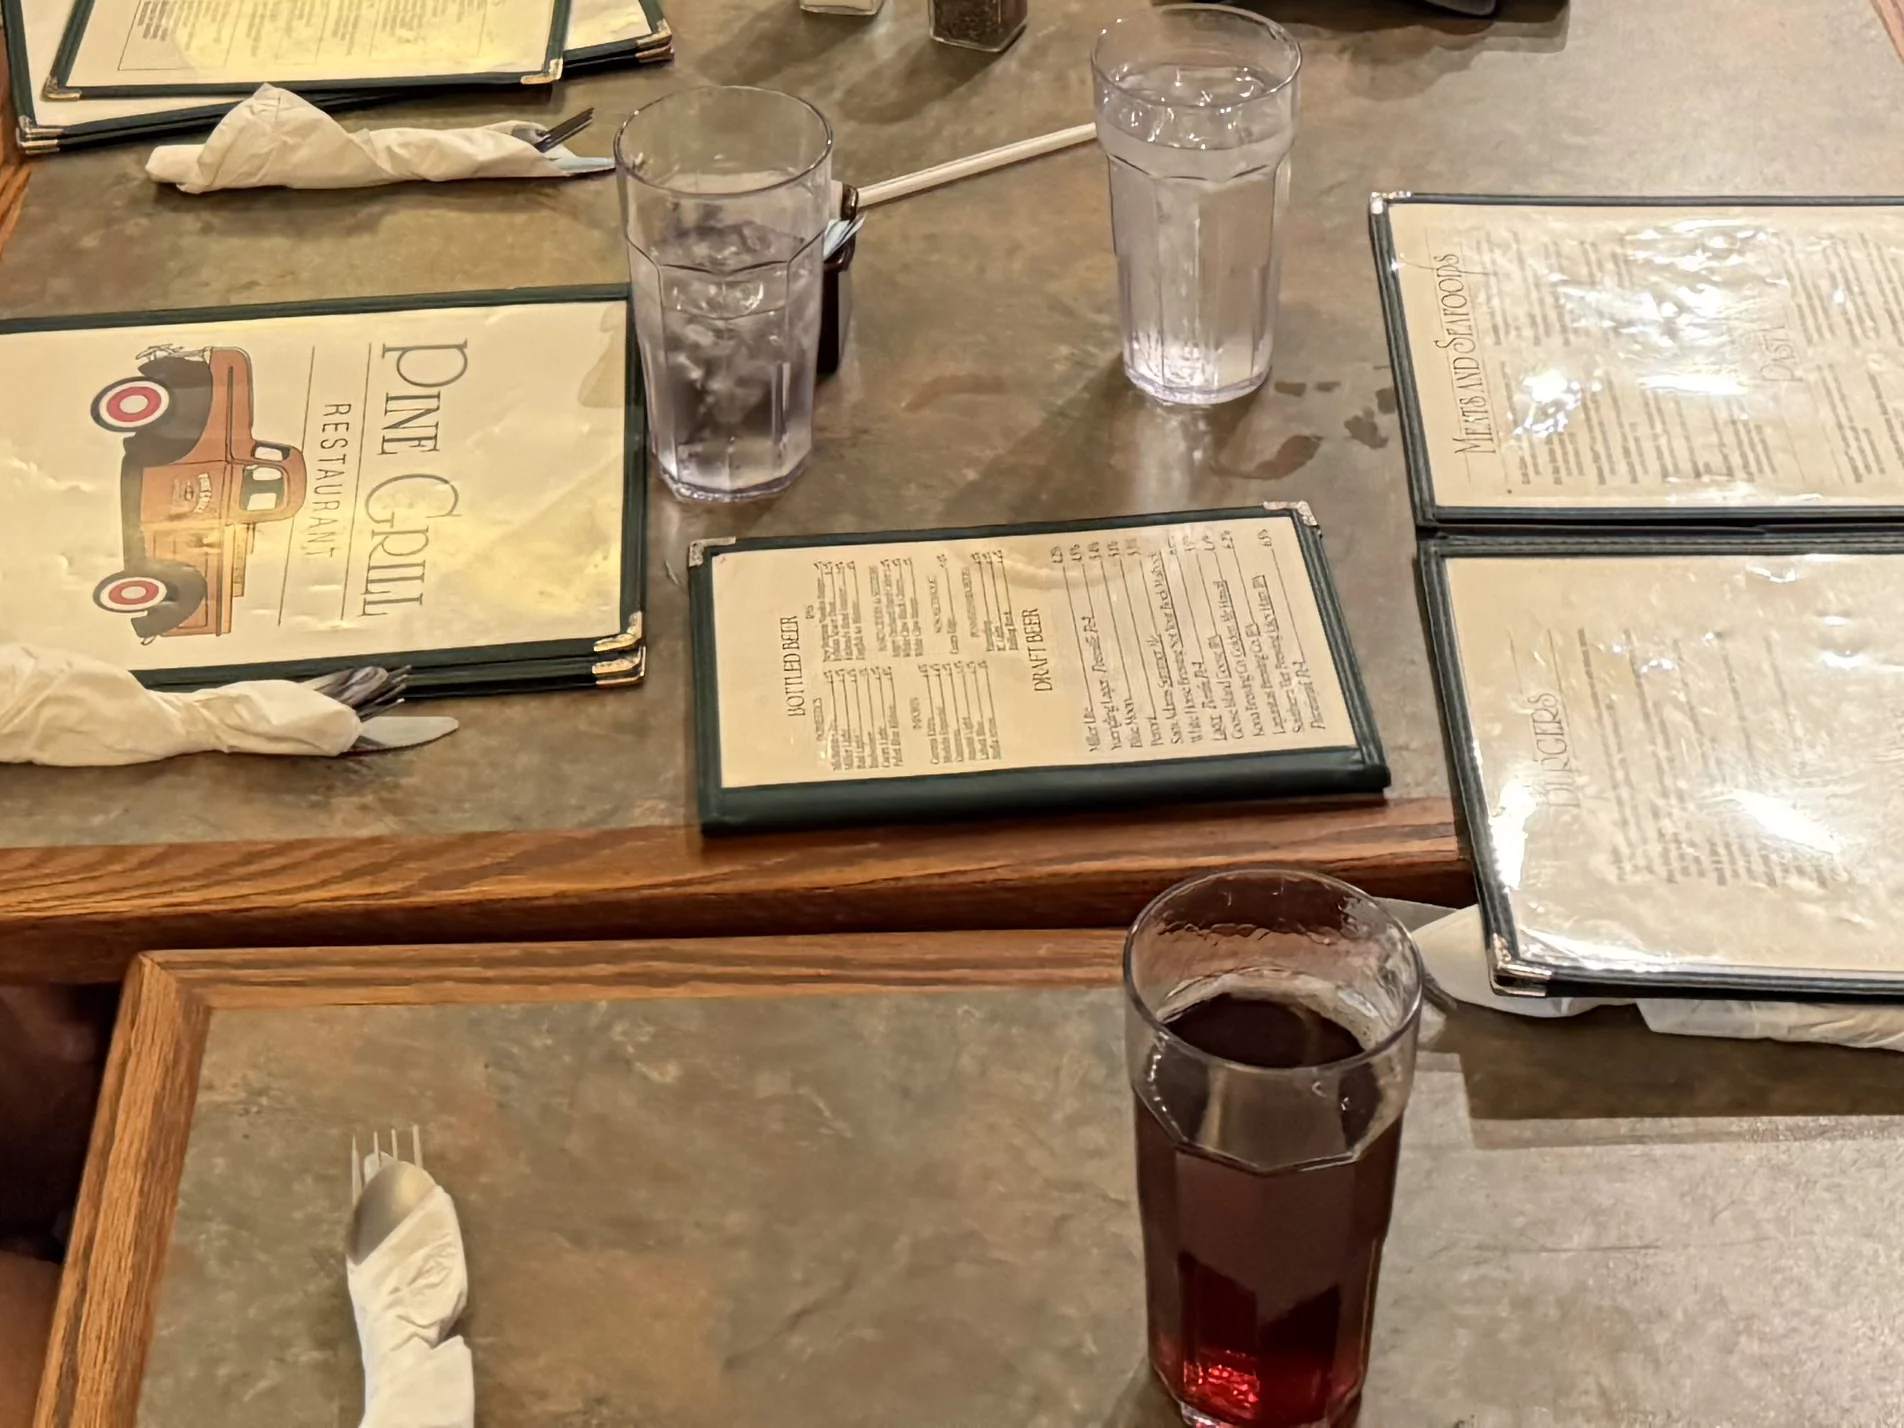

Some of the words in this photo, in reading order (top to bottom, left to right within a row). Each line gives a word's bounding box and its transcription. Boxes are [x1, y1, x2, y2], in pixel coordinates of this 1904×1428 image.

[1431, 254, 1477, 353] SEAFOODS
[1450, 357, 1483, 391] AND
[1759, 325, 1801, 382] PASTA
[377, 338, 468, 455] PINE
[1452, 396, 1496, 454] MEATS
[299, 402, 352, 558] RESTAURANT
[357, 473, 462, 617] GRILL
[780, 616, 799, 650] BEER
[1020, 607, 1044, 643] BEER
[783, 653, 806, 716] BOTTLED
[1027, 645, 1053, 691] DRAFT
